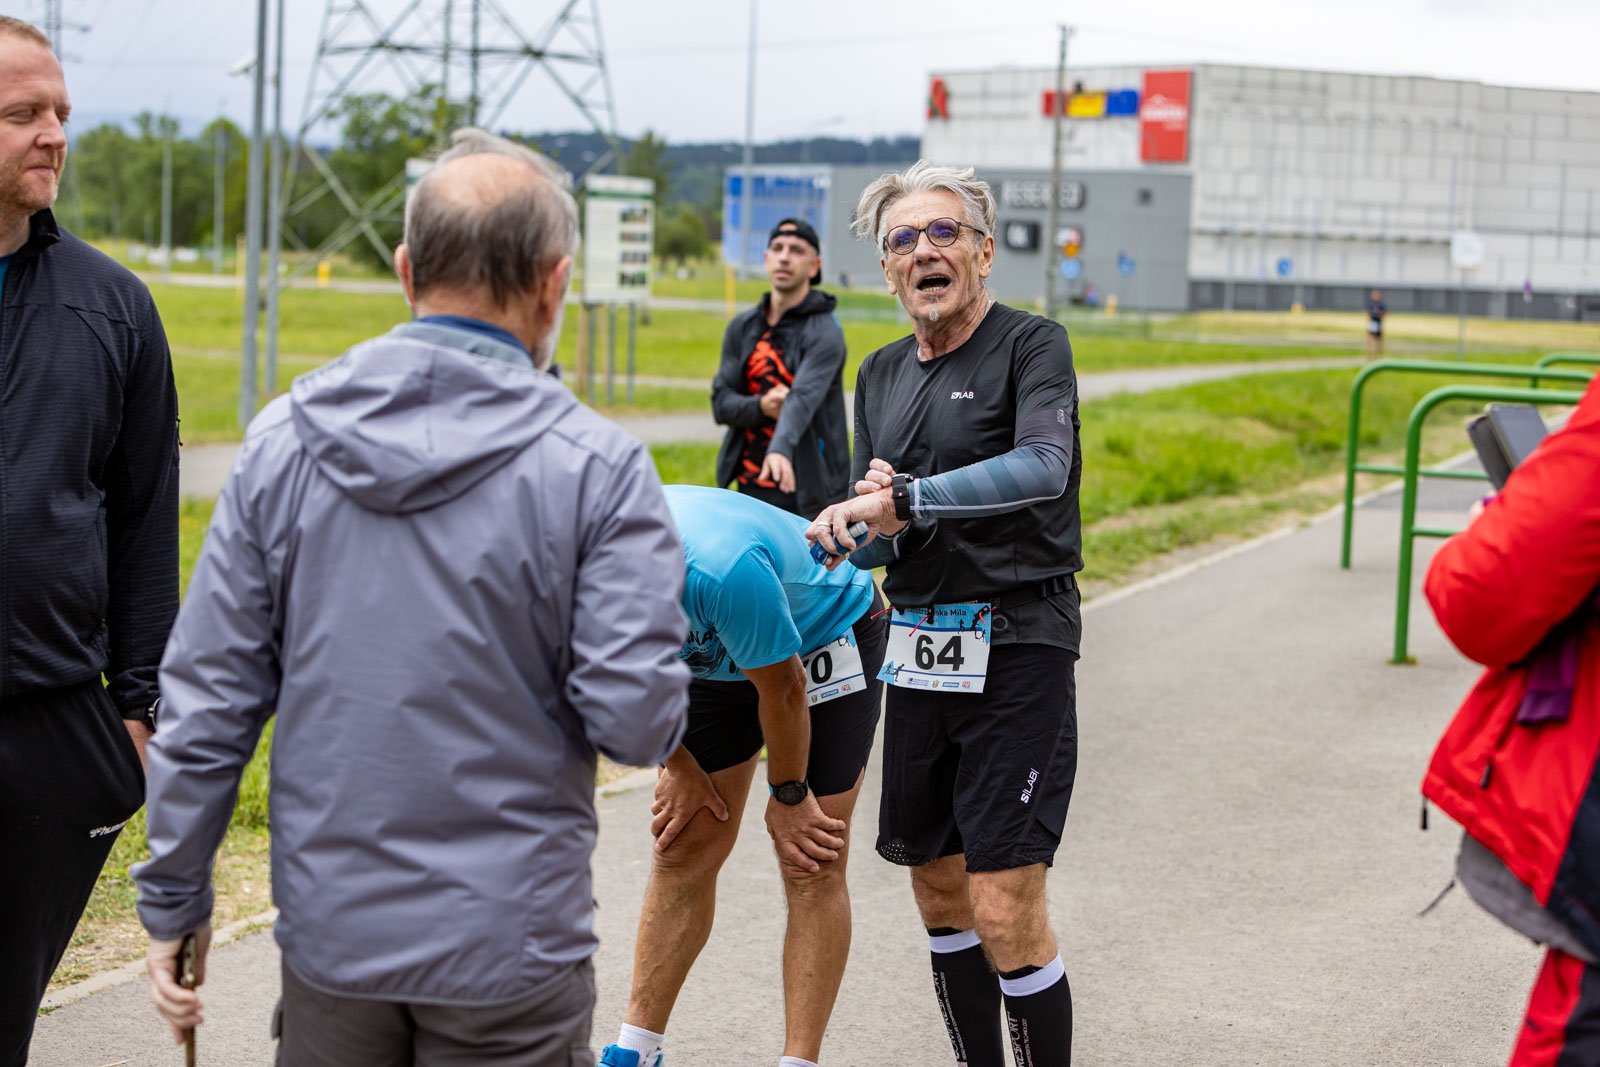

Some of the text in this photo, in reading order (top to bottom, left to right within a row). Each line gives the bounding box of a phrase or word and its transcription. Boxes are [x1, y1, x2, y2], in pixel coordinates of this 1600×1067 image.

[949, 608, 967, 617] Mila
[915, 634, 965, 672] 64
[940, 971, 948, 998] TECHNOLOGY
[1021, 1018, 1030, 1044] TECHNOLOGY
